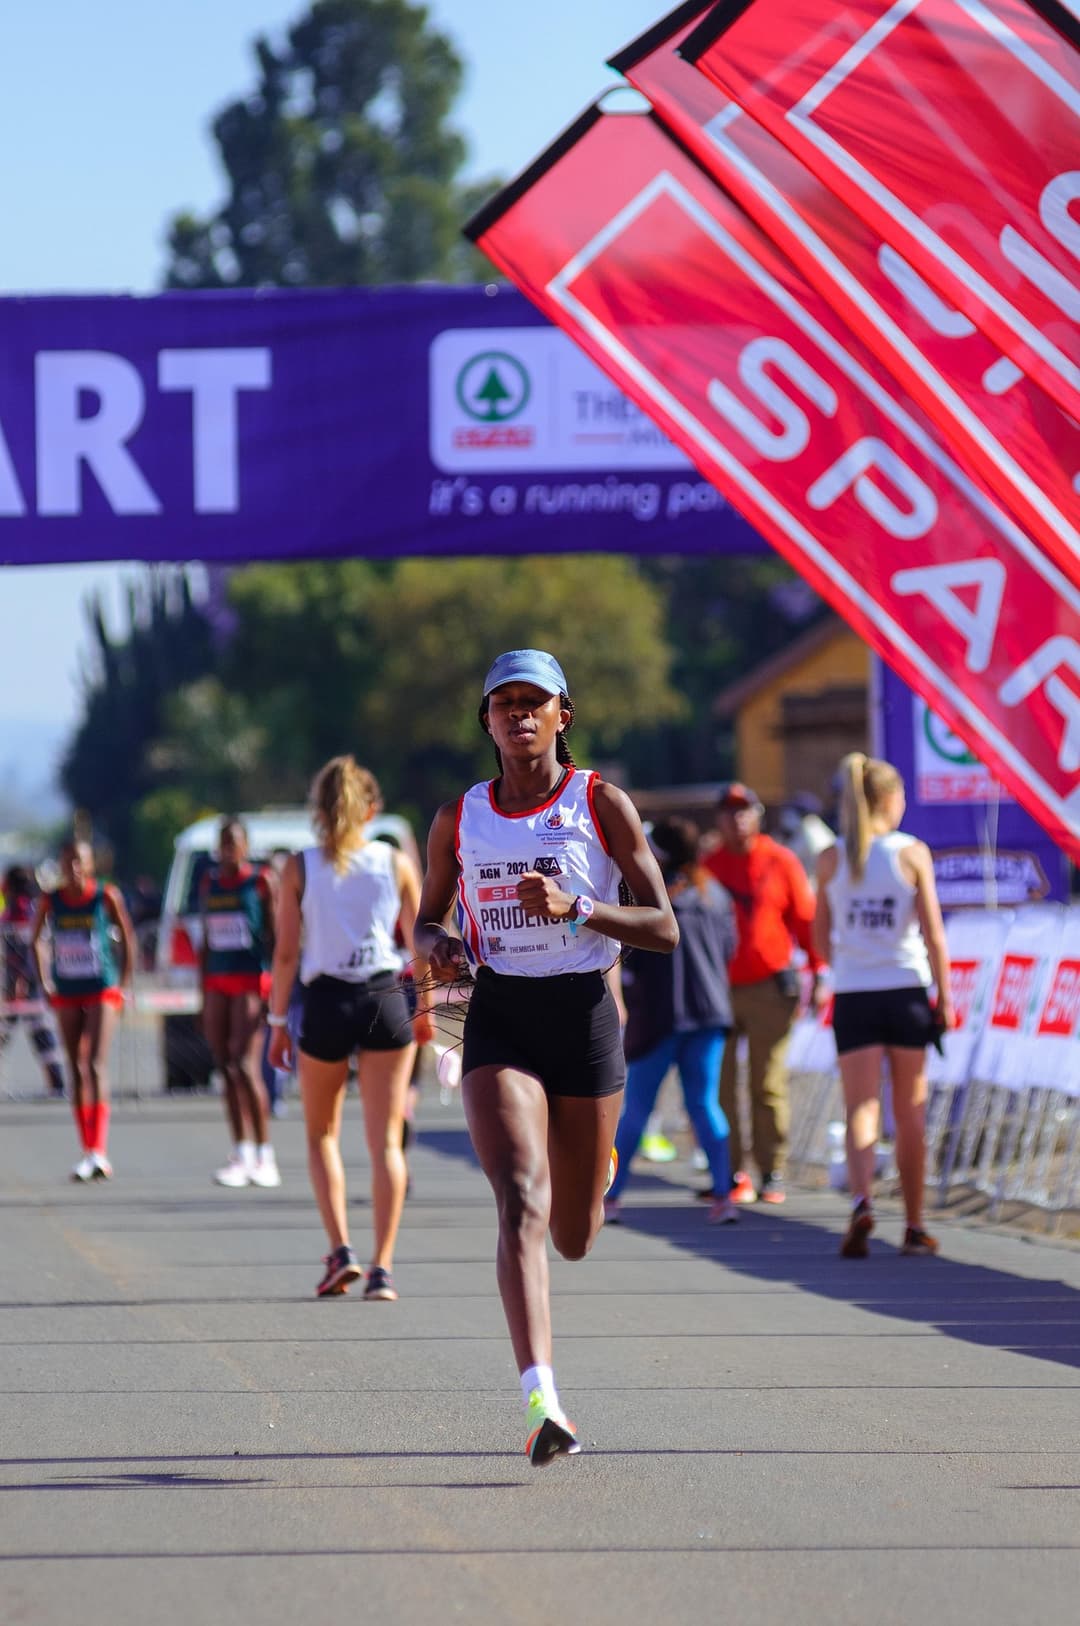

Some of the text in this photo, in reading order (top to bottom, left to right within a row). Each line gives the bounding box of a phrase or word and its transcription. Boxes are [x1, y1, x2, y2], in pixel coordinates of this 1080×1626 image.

[0, 348, 272, 517] RT
[524, 476, 660, 520] running
[706, 336, 1080, 773] SPAR
[480, 862, 529, 880] AGN 2021
[536, 859, 558, 870] ASA
[492, 887, 517, 900] SP
[480, 904, 569, 932] PRUDEN
